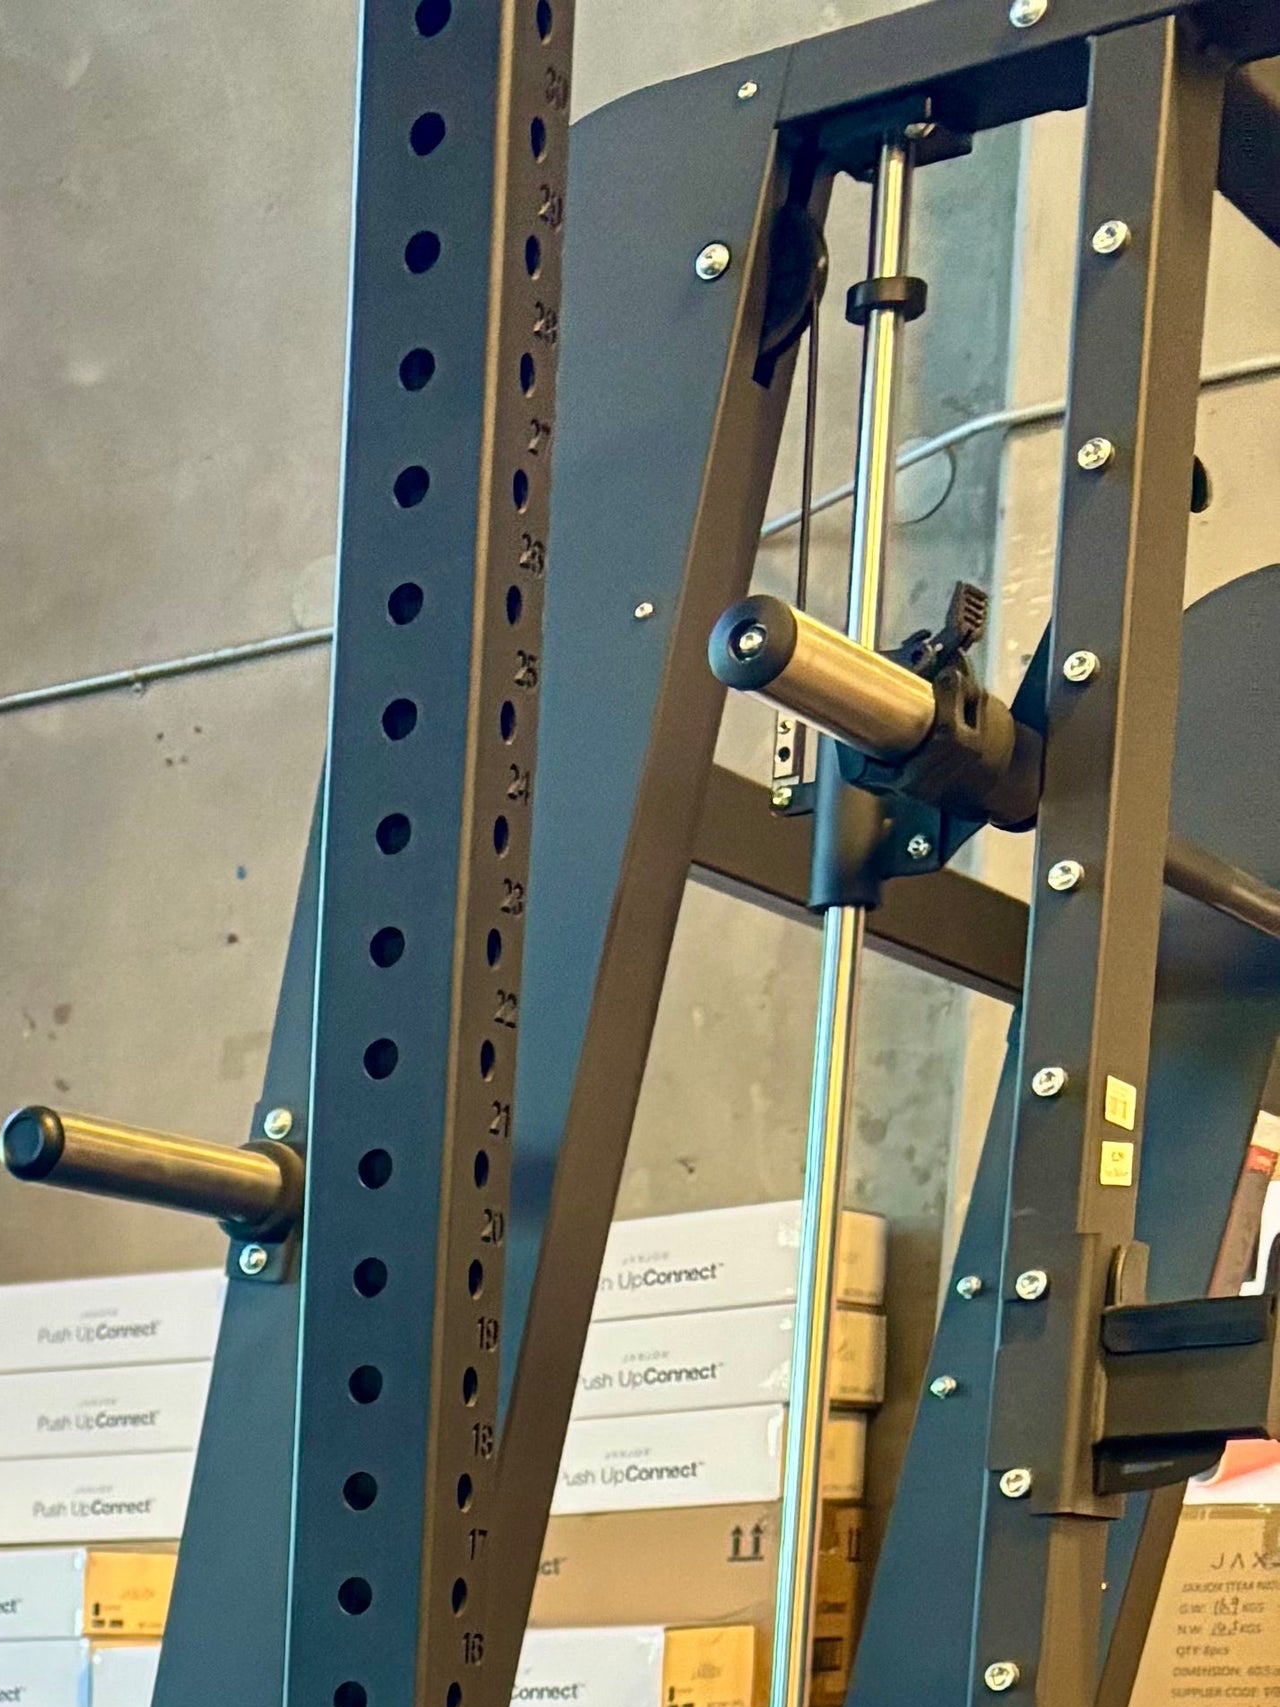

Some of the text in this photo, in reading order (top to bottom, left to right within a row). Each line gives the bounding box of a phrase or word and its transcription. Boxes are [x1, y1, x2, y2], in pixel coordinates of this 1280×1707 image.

[481, 1208, 504, 1247] 20
[476, 1317, 500, 1352] 19
[468, 1526, 489, 1561] 17
